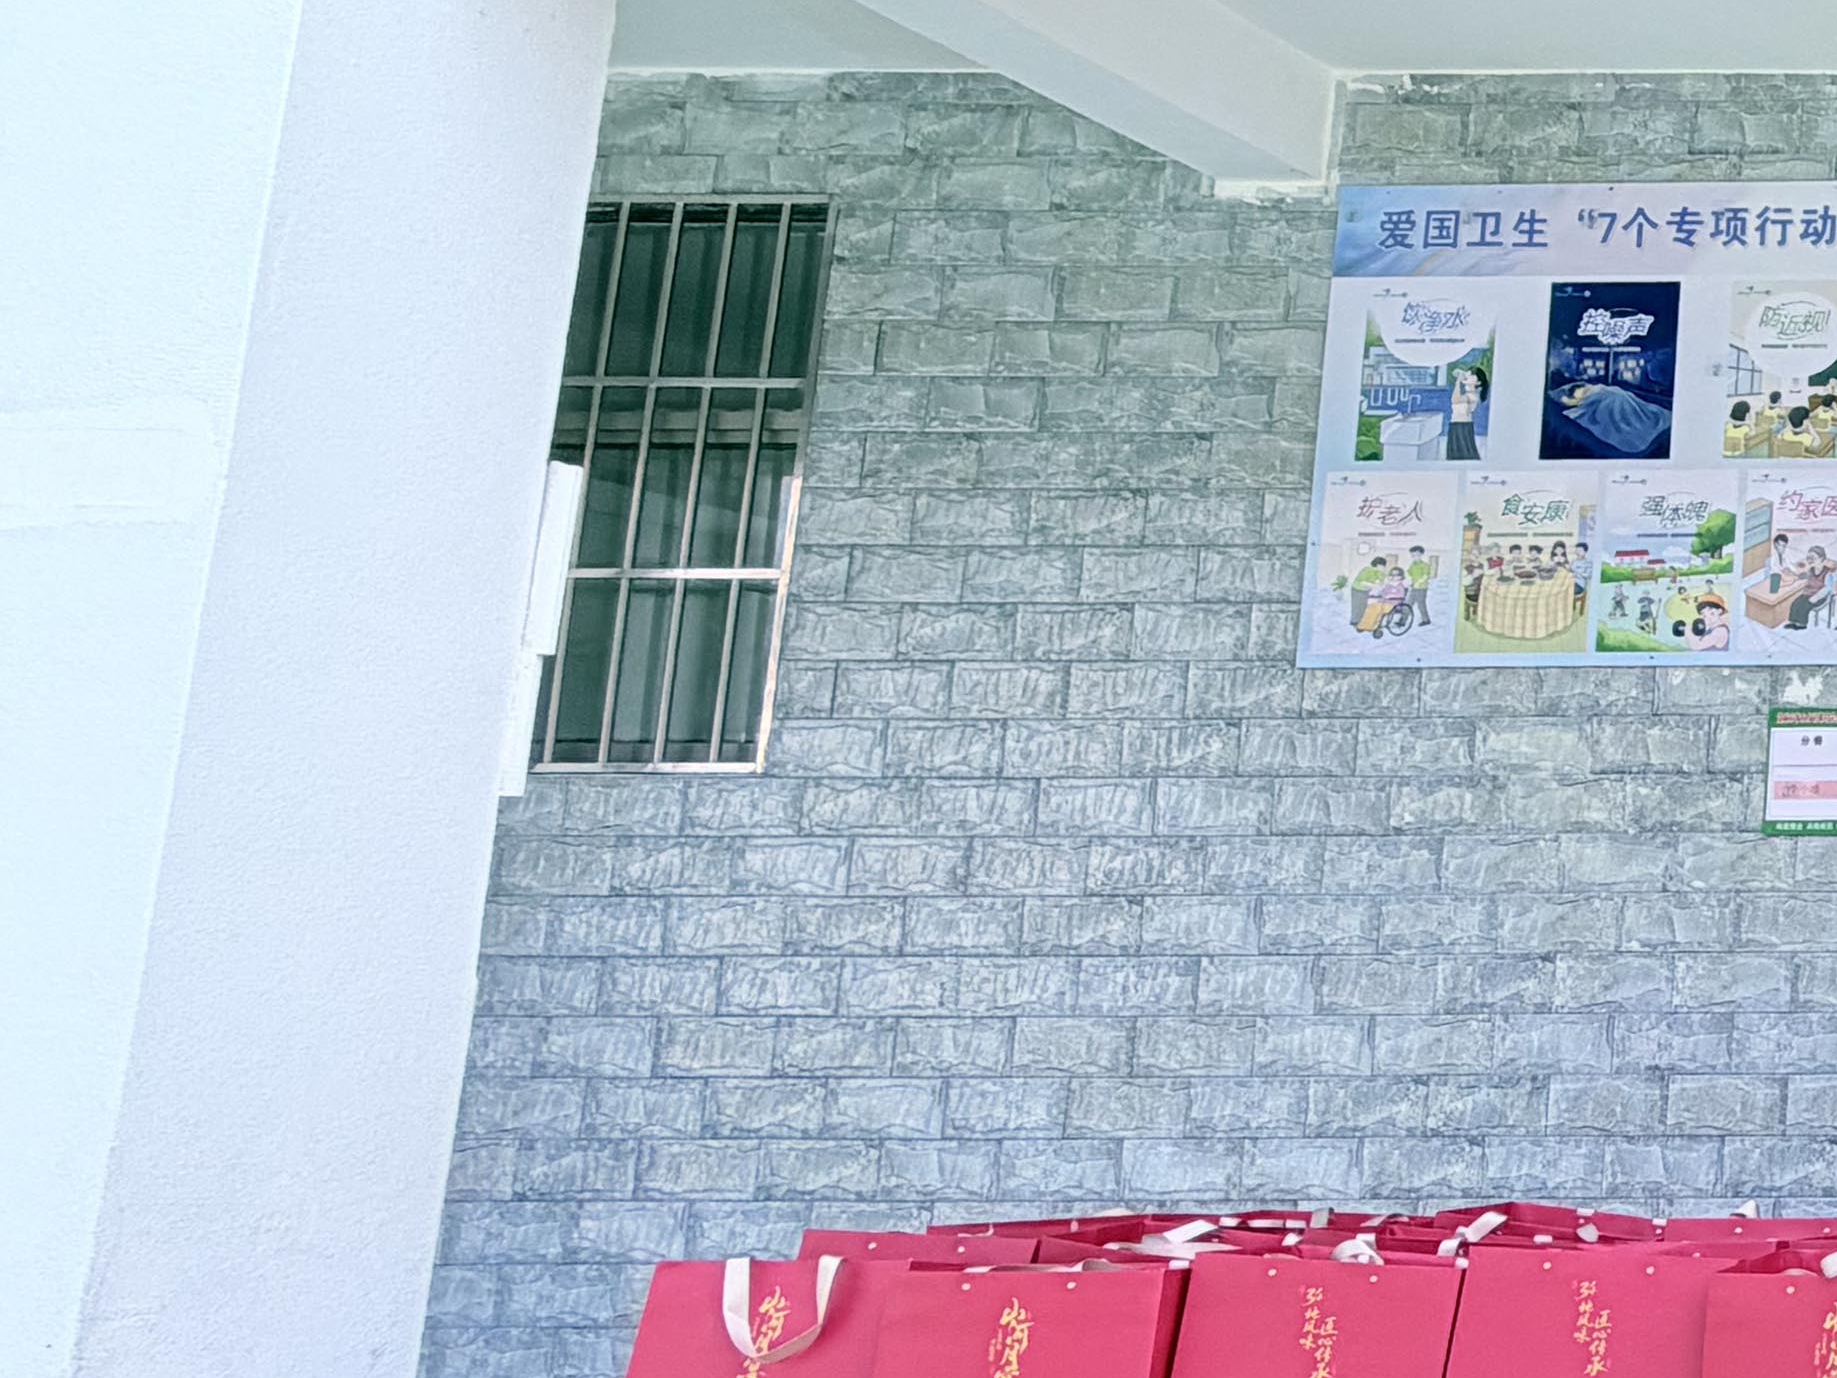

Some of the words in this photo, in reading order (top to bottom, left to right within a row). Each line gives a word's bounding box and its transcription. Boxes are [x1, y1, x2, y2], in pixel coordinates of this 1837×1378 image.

[1378, 208, 1549, 251] 爱国卫生
[1758, 304, 1829, 339] 防近视
[1358, 496, 1423, 526] 护老人
[1501, 494, 1570, 526] 食安康
